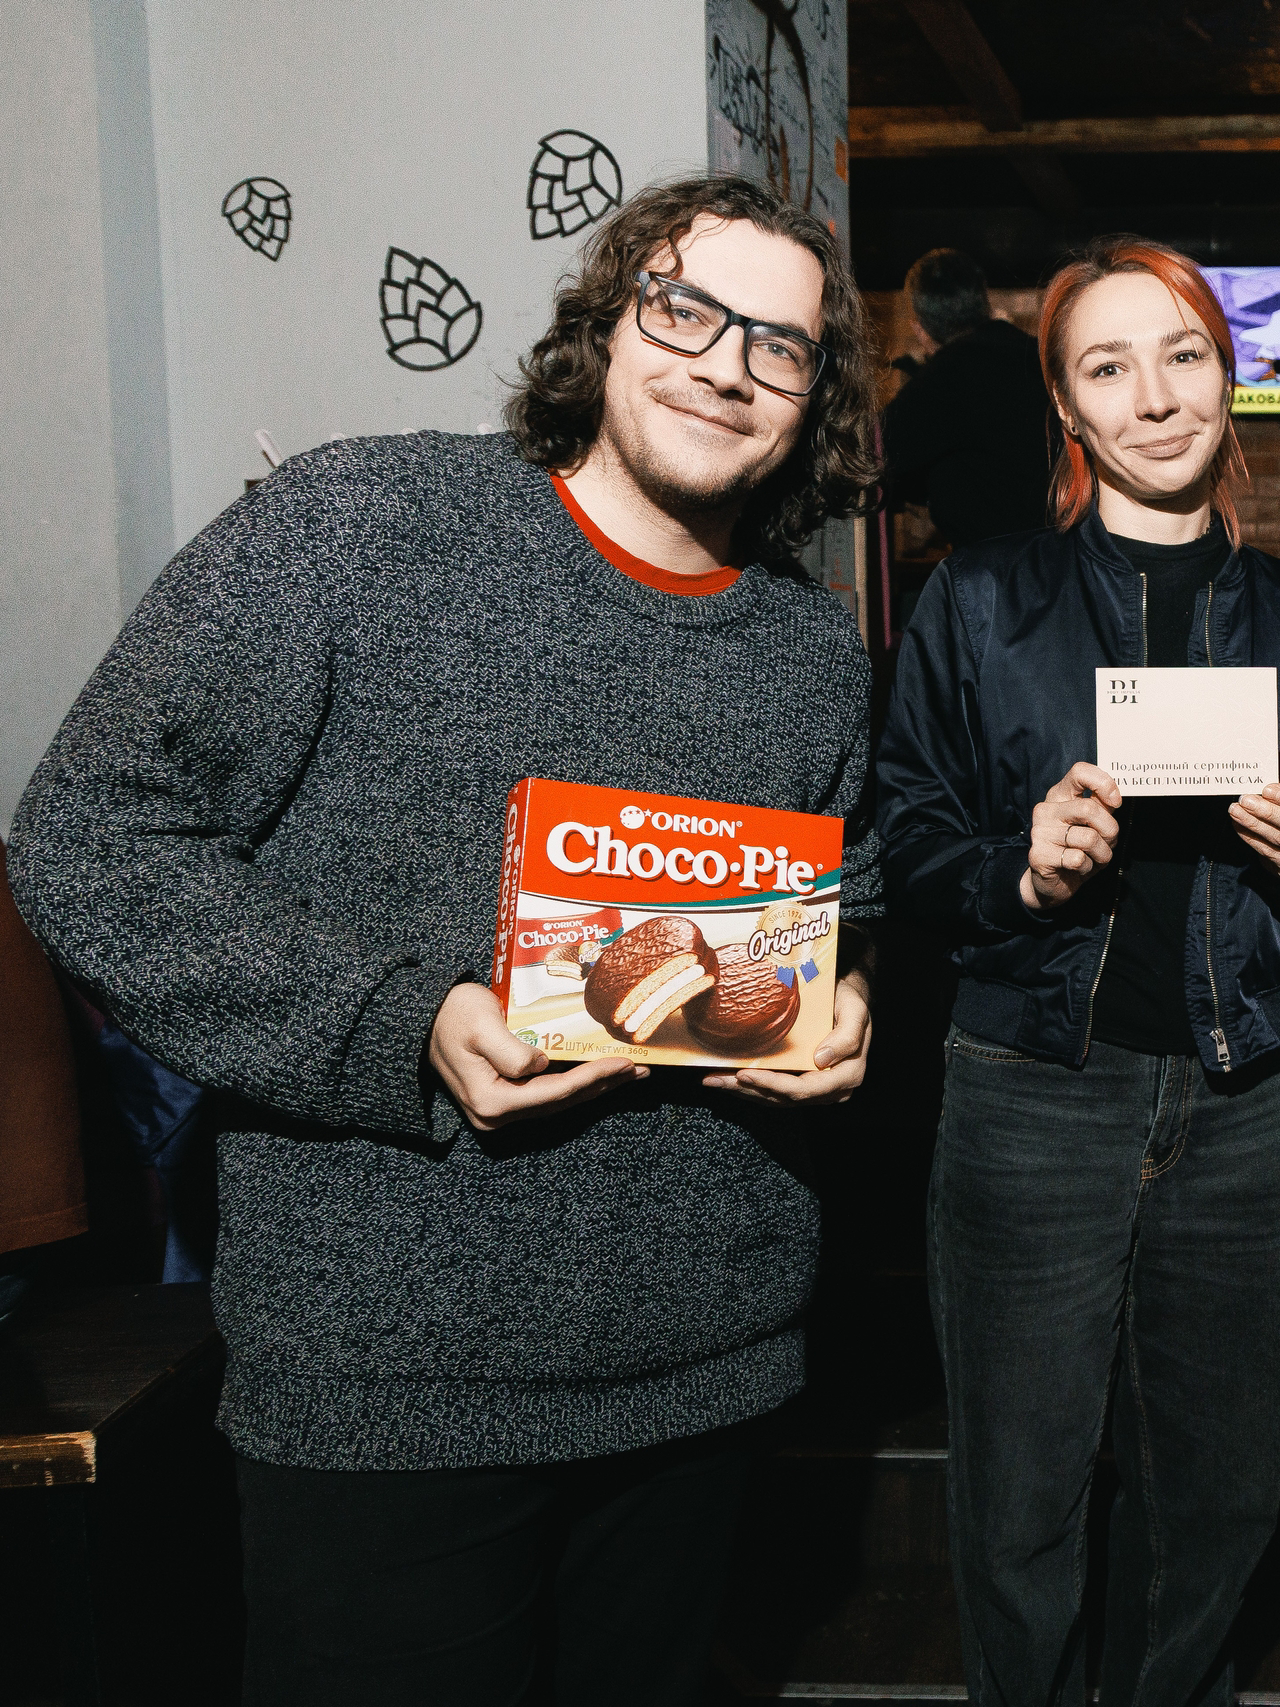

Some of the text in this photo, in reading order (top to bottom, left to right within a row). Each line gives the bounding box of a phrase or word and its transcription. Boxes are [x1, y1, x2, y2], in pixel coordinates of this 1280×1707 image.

[1111, 759, 1189, 772] Подарочный
[1132, 775, 1210, 786] БЕСПЛАТНЫЙ
[1215, 775, 1264, 785] МАССАЖ
[651, 812, 736, 838] ORION
[768, 909, 803, 924] SINCE 1974
[553, 920, 582, 929] ORION
[748, 911, 831, 962] Original
[541, 1033, 565, 1051] 12
[596, 1045, 649, 1057] NET WT 360g
